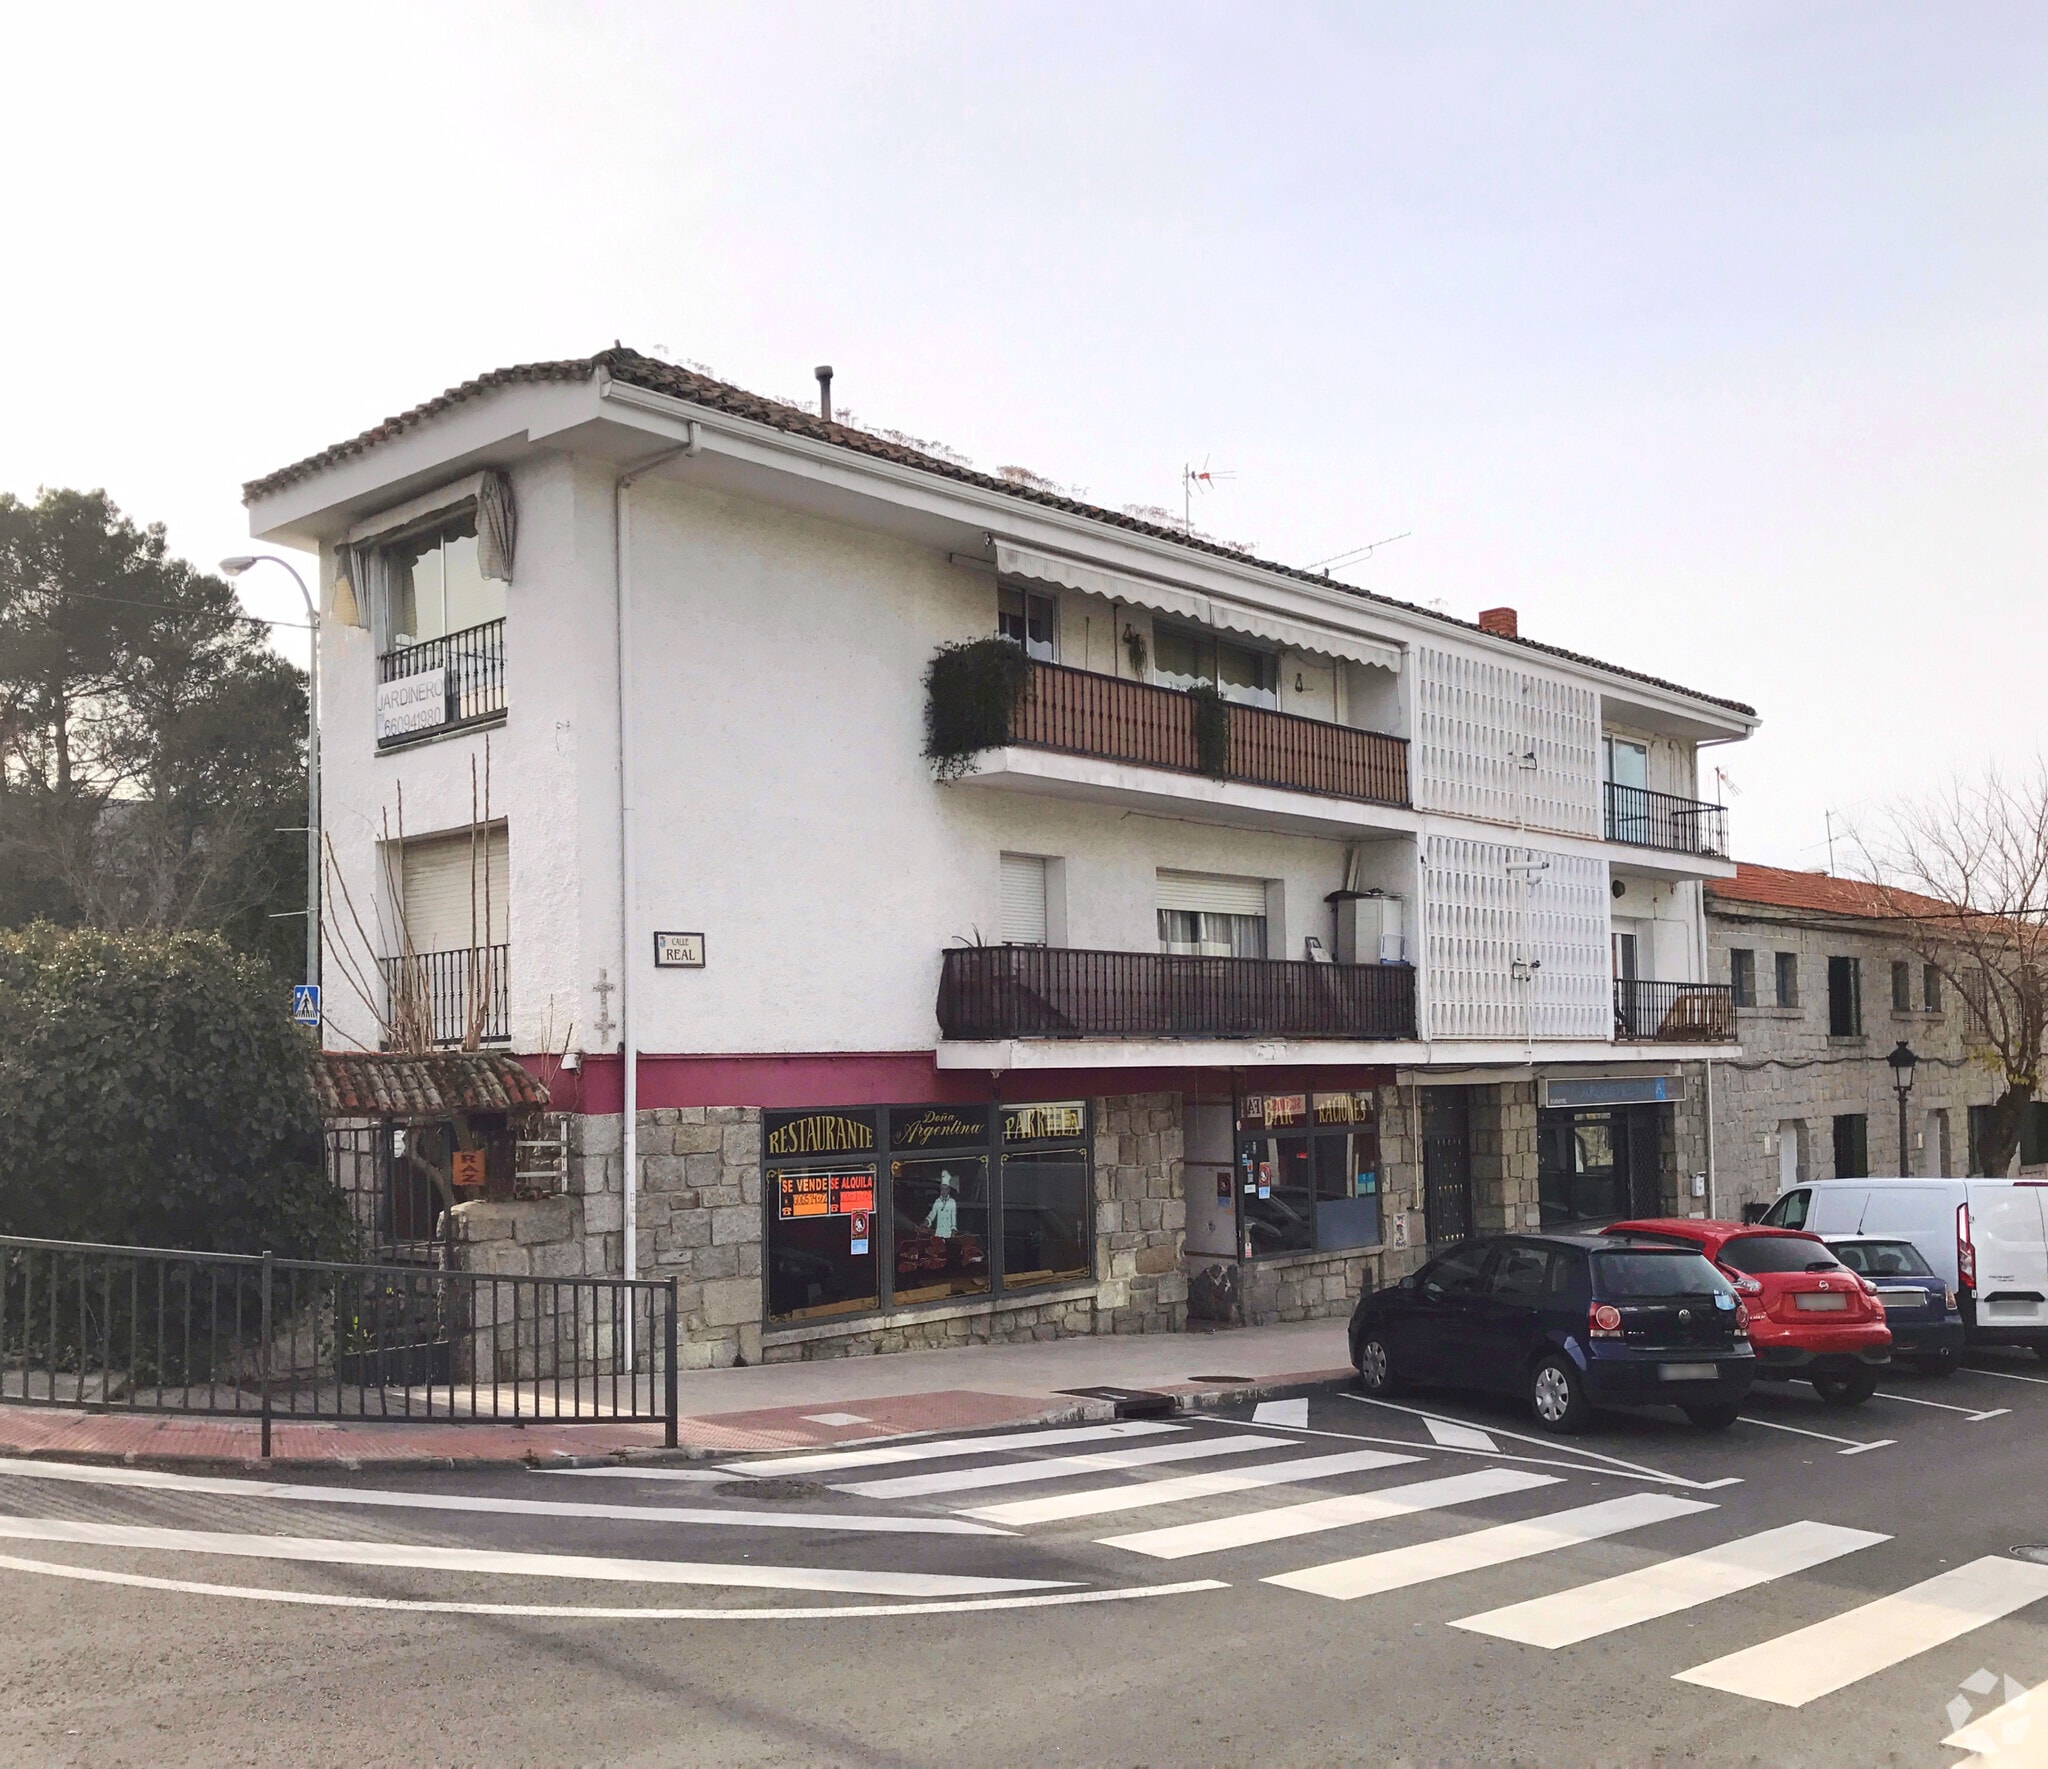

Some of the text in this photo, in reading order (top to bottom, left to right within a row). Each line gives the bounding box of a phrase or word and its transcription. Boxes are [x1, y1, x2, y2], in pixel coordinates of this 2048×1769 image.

[377, 678, 444, 712] JARDINERO
[666, 948, 695, 961] REAL
[671, 937, 689, 946] CALLE
[923, 1111, 955, 1124] Doña
[1263, 1097, 1294, 1126] BAR
[1318, 1095, 1367, 1123] RACIONES
[768, 1115, 874, 1154] RESTAURANTE
[893, 1119, 985, 1146] Argentina
[1005, 1107, 1081, 1140] PARRILLA
[782, 1177, 828, 1193] SE VENDE
[830, 1176, 873, 1190] SE ALQUILA
